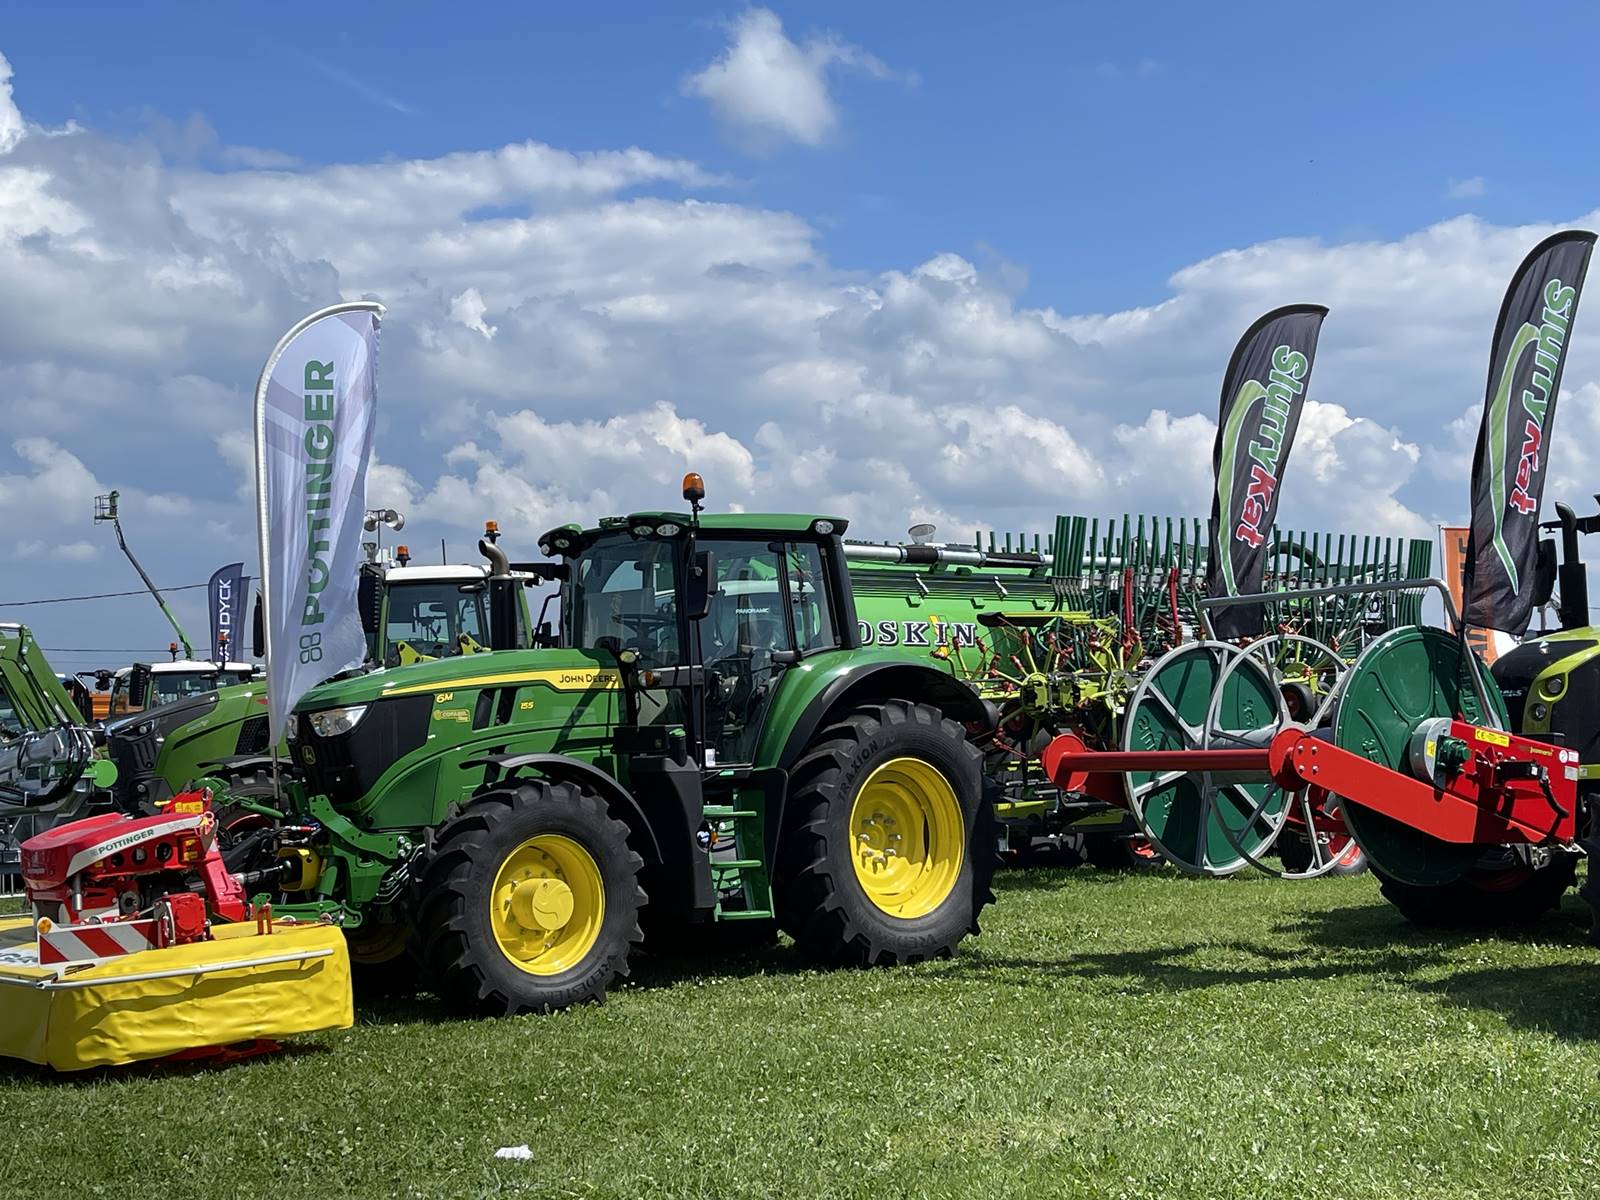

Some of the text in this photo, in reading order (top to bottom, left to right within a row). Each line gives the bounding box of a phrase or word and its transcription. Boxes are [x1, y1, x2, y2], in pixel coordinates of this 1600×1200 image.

[219, 579, 231, 626] DYCK
[857, 619, 977, 647] OSKIN
[559, 673, 617, 683] JOHN DEERE
[436, 691, 454, 704] 6M
